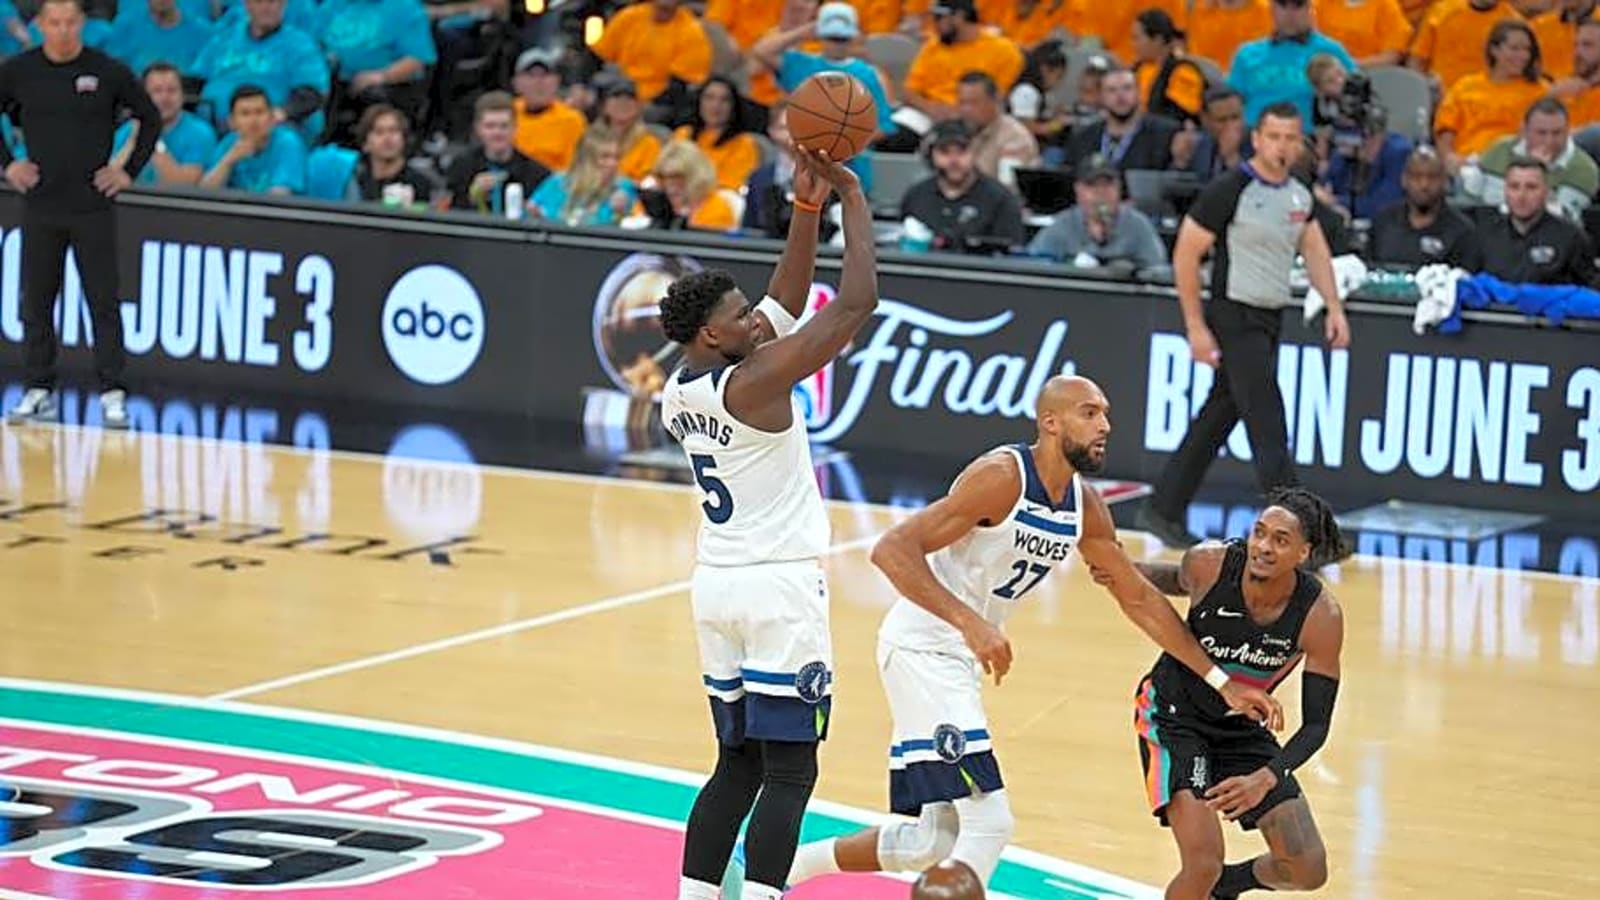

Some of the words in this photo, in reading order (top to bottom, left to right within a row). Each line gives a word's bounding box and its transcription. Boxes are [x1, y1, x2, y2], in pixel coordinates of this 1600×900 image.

[120, 240, 283, 366] JUNE
[293, 254, 334, 371] 3
[392, 301, 474, 342] abc
[808, 299, 1076, 443] Final
[671, 410, 733, 447] DWARDS
[1144, 332, 1349, 467] BIN
[1360, 353, 1550, 486] JUNE
[1562, 366, 1600, 492] 3
[689, 452, 734, 525] 5
[1013, 528, 1070, 561] WOLVES
[992, 559, 1052, 600] 27
